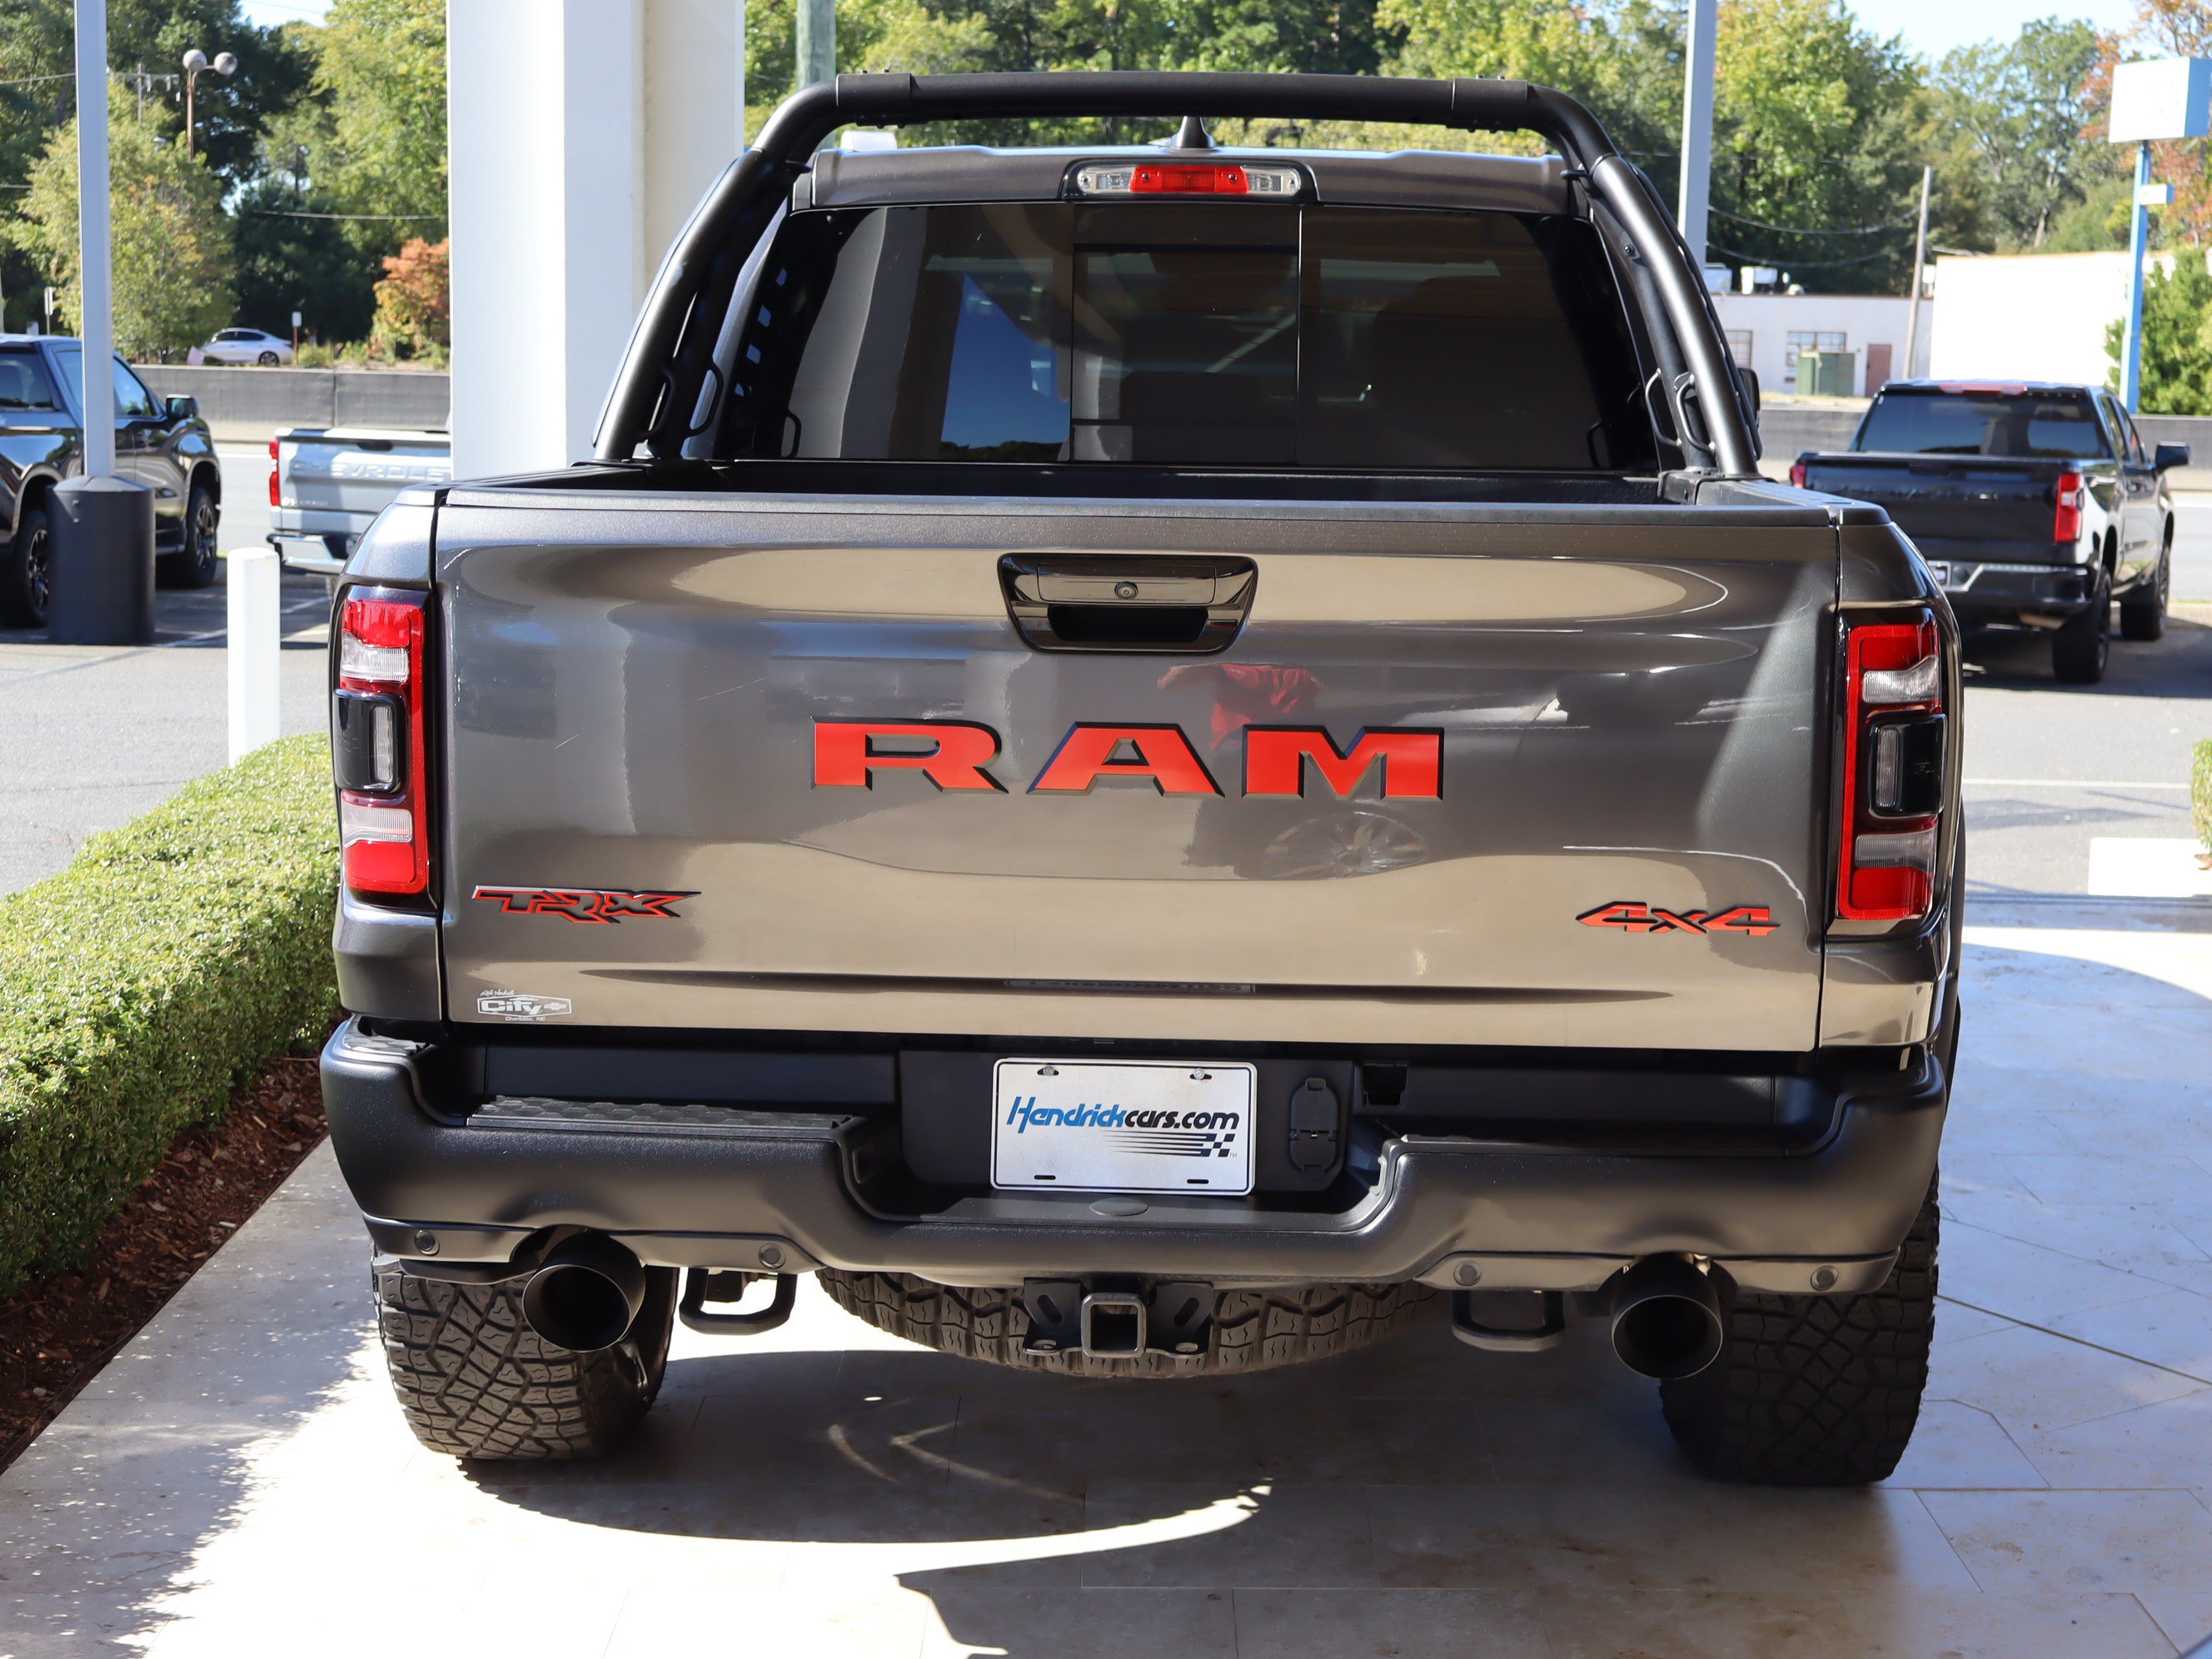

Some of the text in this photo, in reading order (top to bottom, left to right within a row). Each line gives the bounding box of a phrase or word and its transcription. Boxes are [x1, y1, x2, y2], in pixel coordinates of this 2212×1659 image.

[810, 717, 1444, 800] RAM
[471, 885, 702, 924] TRX
[481, 999, 542, 1015] City
[1006, 1096, 1239, 1133] Hendrickcars.com
